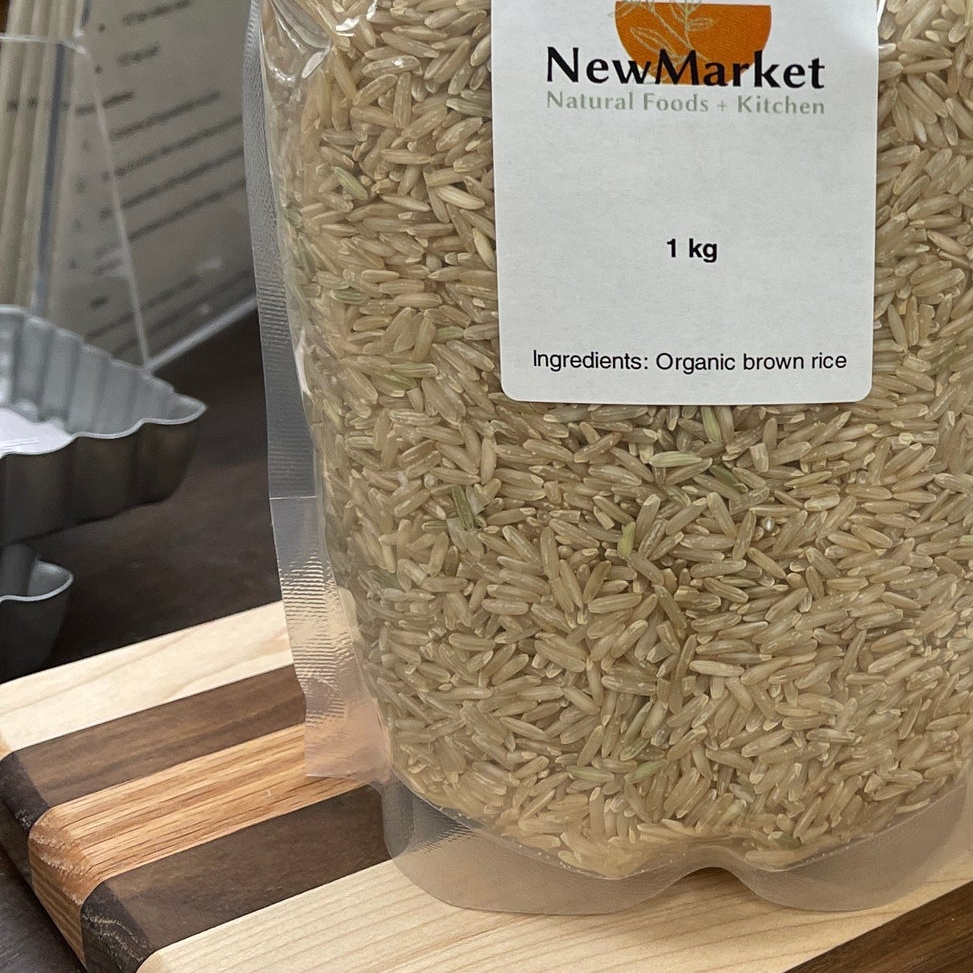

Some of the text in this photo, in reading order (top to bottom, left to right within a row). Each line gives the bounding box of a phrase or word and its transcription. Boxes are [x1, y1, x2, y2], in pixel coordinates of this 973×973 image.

[546, 46, 826, 90] NewMarket
[546, 90, 825, 115] Natural Foods + Kitchen
[666, 237, 718, 264] 1 kg
[533, 349, 848, 376] Ingredients: Organic brown rice
